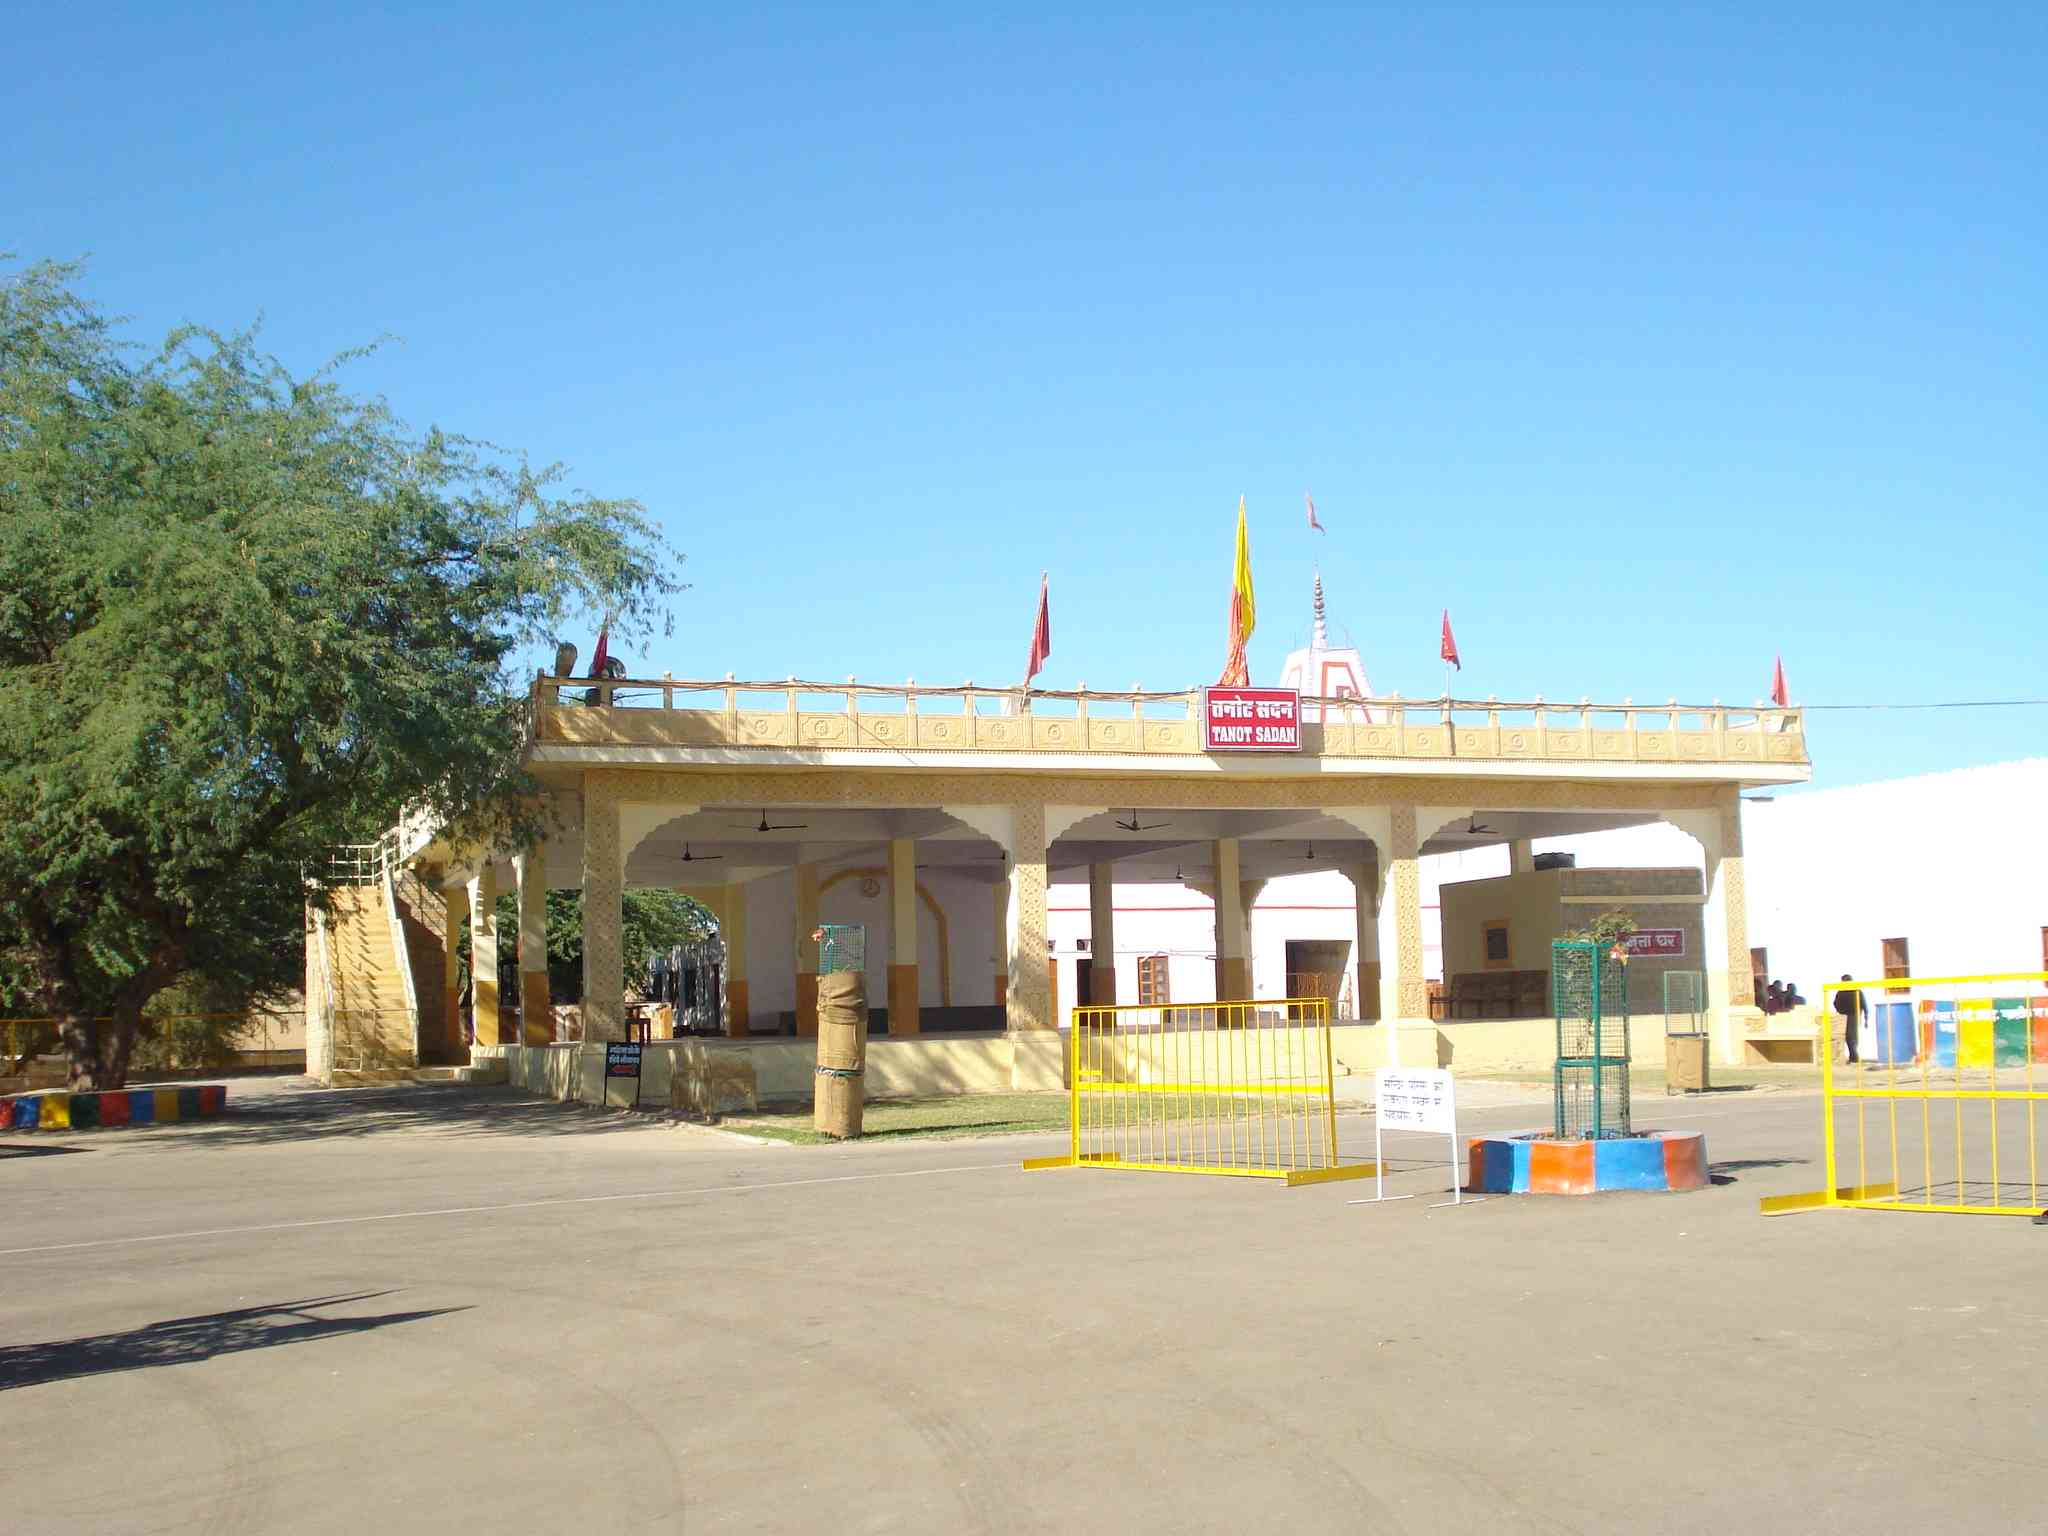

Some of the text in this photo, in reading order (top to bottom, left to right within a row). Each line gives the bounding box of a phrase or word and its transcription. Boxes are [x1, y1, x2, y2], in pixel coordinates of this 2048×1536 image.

[1210, 694, 1294, 719] तनोट सदन
[1212, 726, 1295, 743] TANOT SADAN
[1655, 935, 1676, 947] घर
